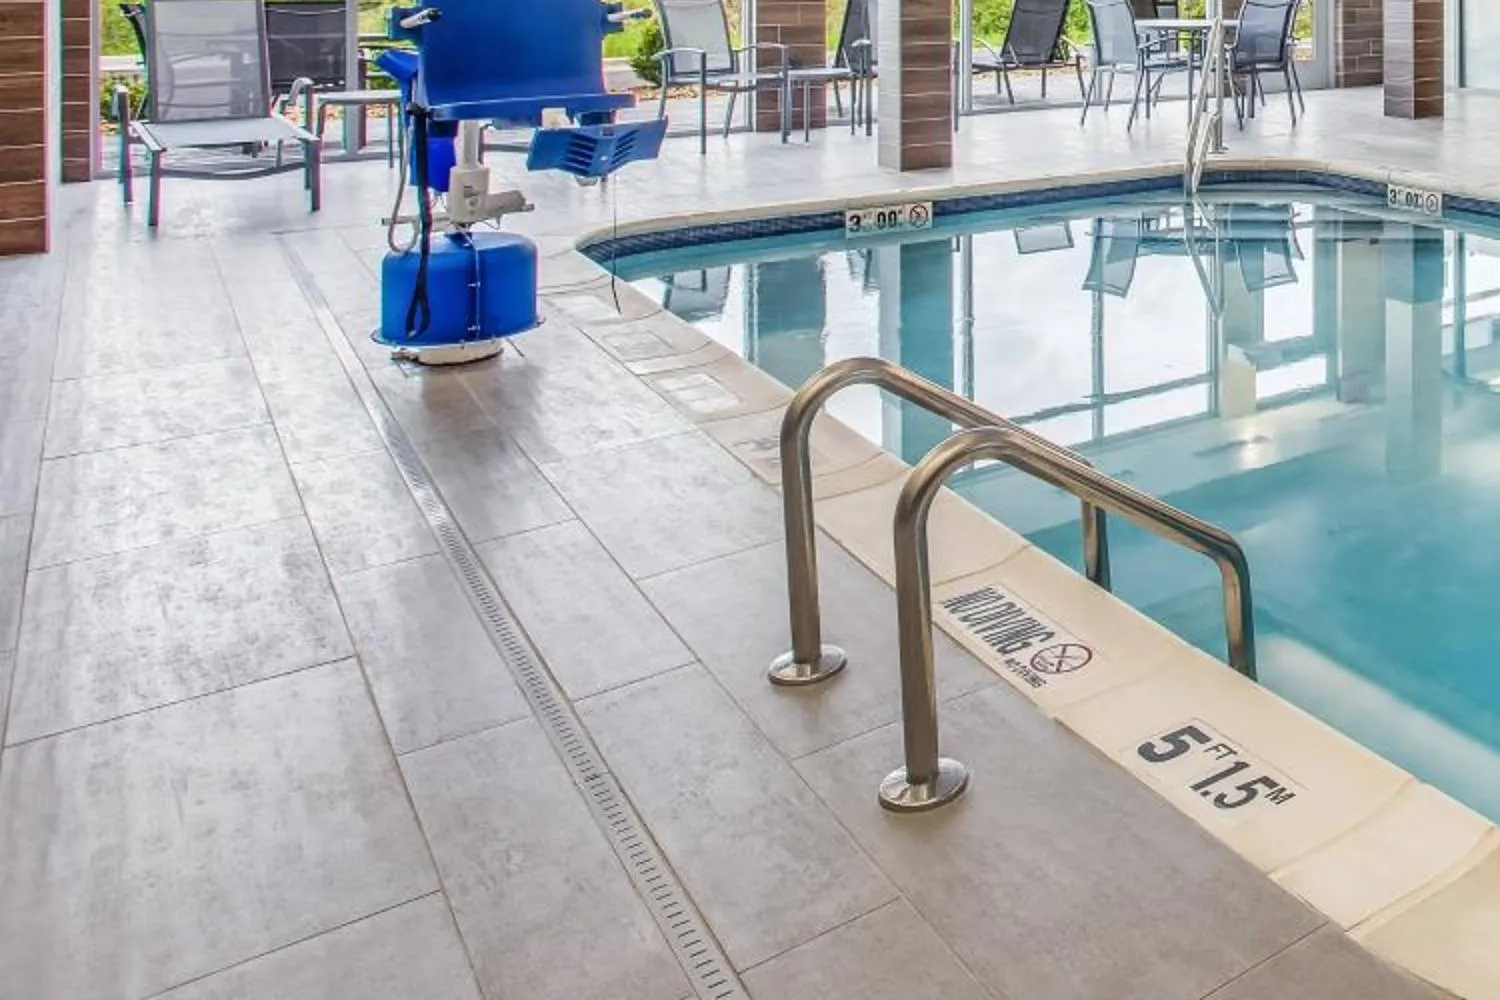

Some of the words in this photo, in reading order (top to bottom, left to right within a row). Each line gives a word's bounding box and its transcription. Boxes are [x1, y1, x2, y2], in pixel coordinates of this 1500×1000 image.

[848, 213, 862, 232] 3
[941, 587, 1006, 614] NO
[958, 601, 1056, 656] DIVING
